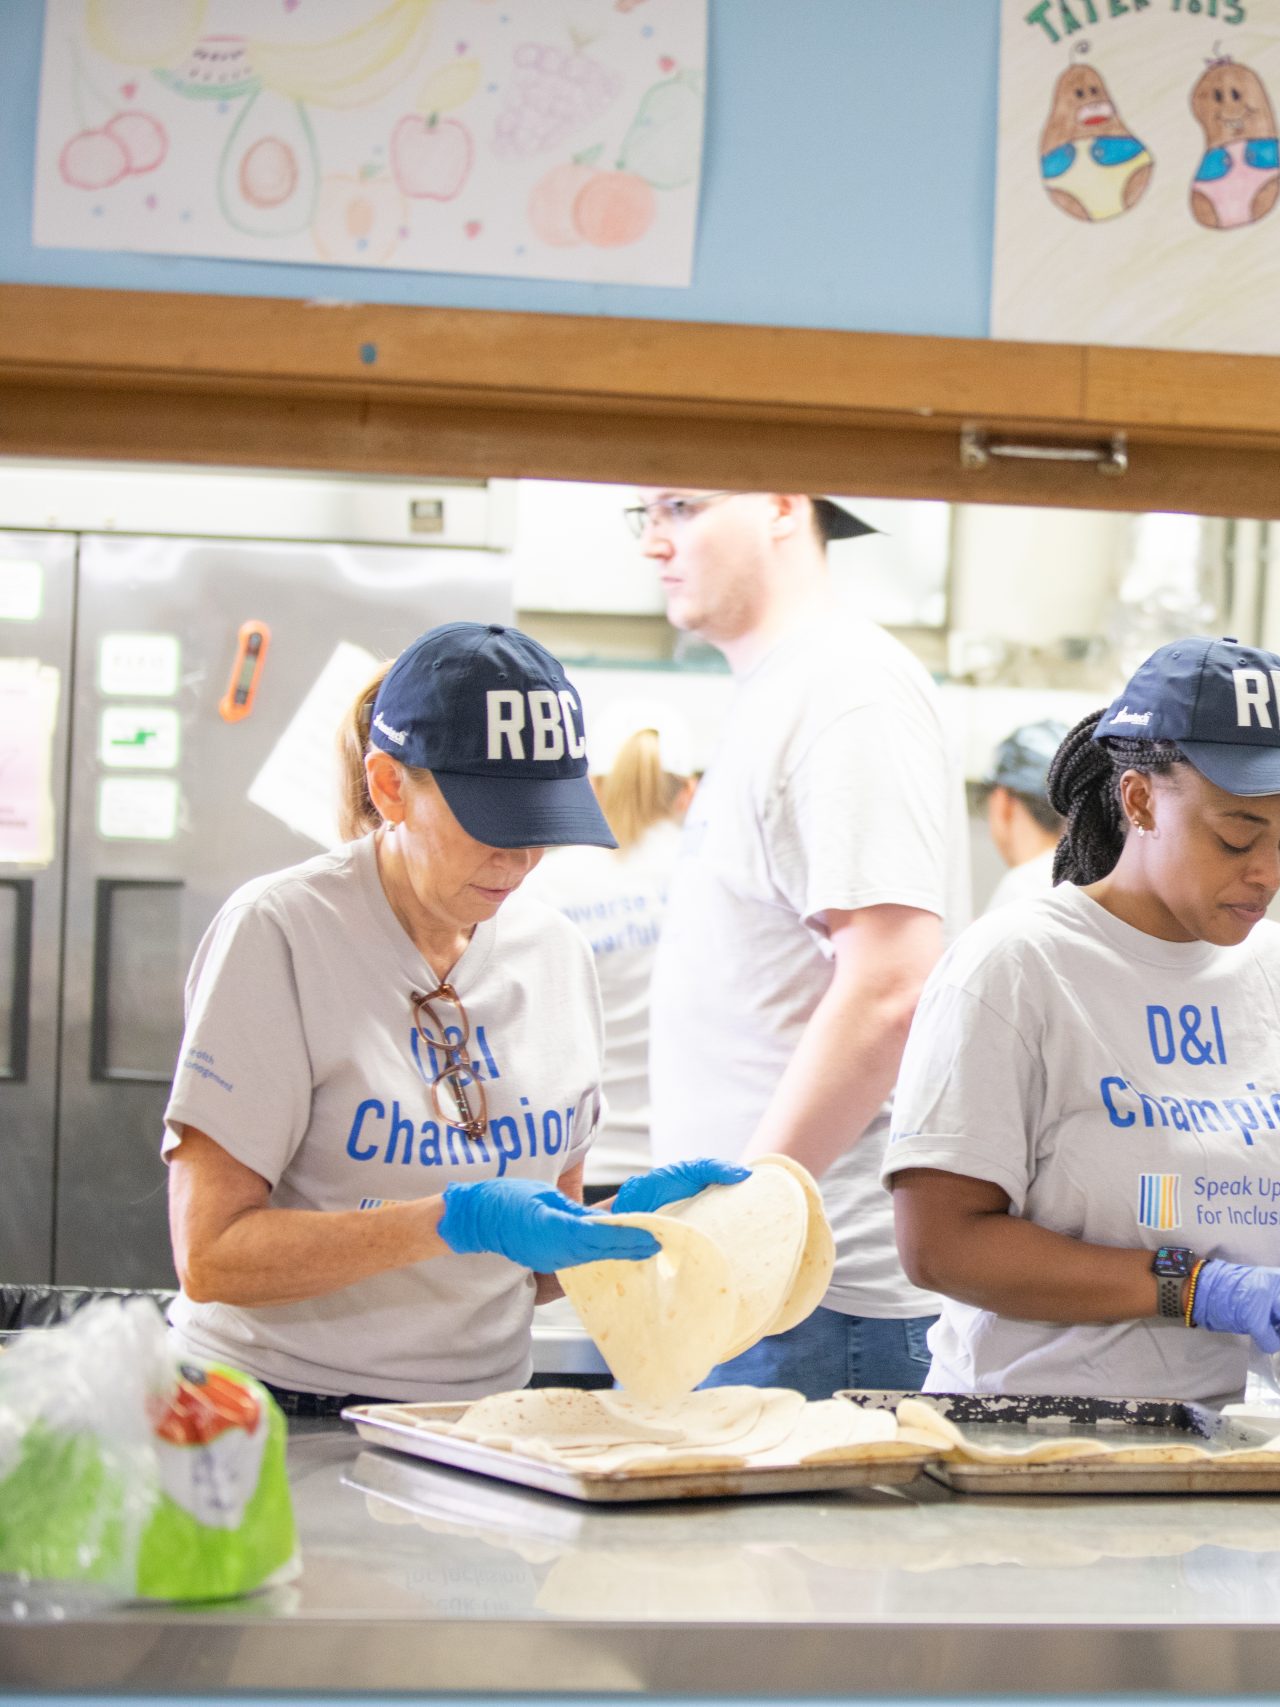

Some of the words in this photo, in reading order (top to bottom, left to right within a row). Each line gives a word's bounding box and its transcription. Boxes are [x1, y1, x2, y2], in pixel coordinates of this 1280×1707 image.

[486, 690, 585, 762] RBC
[1146, 1004, 1227, 1065] D&I
[1194, 1175, 1253, 1202] Speak
[1196, 1204, 1223, 1226] for
